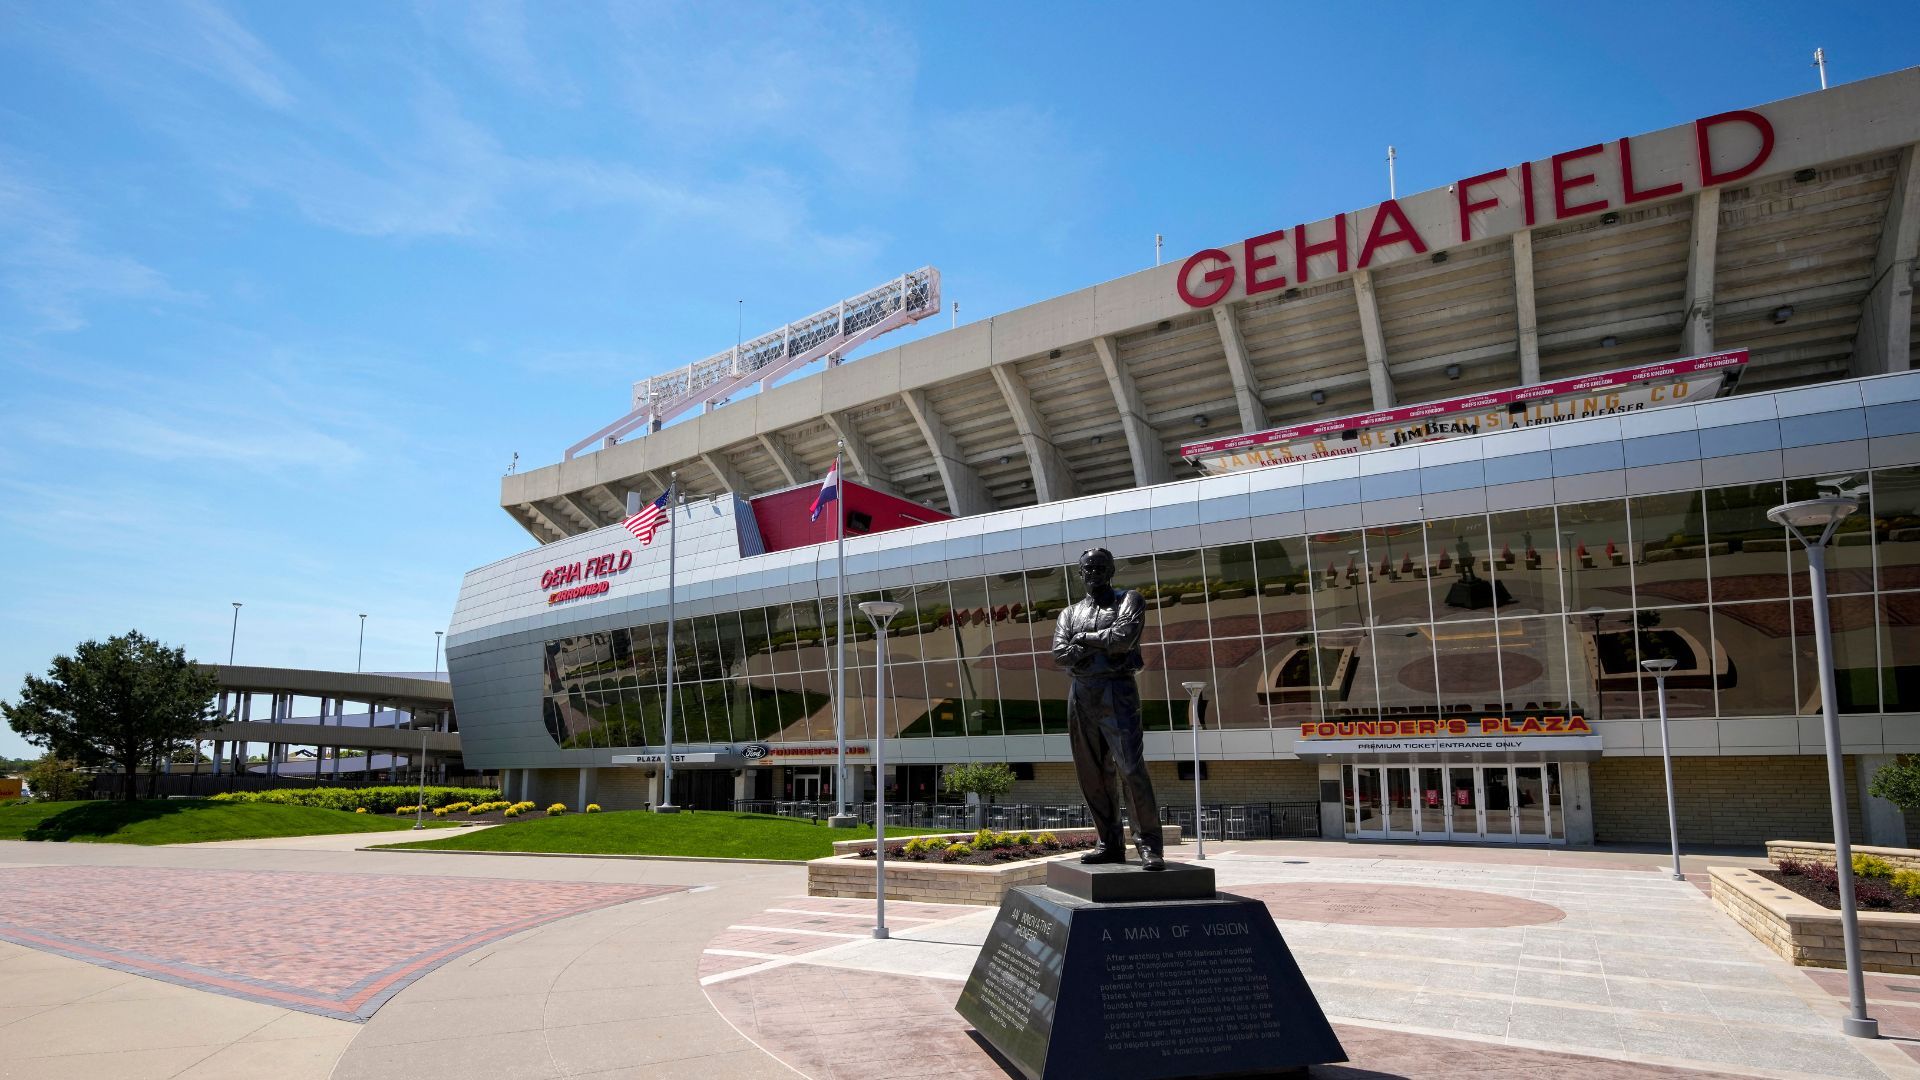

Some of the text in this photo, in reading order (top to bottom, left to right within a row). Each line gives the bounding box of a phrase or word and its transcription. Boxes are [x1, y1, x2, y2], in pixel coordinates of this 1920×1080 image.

[1176, 110, 1775, 307] GEHA FIELD
[1713, 358, 1738, 366] KINGDOM
[1651, 368, 1675, 377] KINGDOM
[1512, 421, 1519, 429] A
[1526, 413, 1575, 427] CROWN
[1390, 422, 1480, 447] JIM BEAM
[1219, 446, 1293, 469] JAMES
[1260, 446, 1358, 467] KENTUCKY STRAIGHT
[541, 549, 633, 590] GEHA FIELD
[556, 580, 609, 602] ARROWHEAD
[1300, 715, 1593, 738] FOUNDER'S PLAZA
[745, 746, 762, 758] Ford
[1102, 922, 1249, 941] A MAN OF VISION
[1106, 953, 1125, 961] After
[1128, 952, 1160, 961] watching
[1194, 949, 1223, 957] National
[1224, 947, 1252, 955] Football
[1106, 963, 1134, 971] League
[1136, 960, 1184, 969] Championship
[1113, 973, 1135, 981] Lamar
[1138, 971, 1154, 979] Hunt
[1156, 969, 1196, 977] recognized
[1211, 966, 1253, 974] tremendous
[1100, 983, 1132, 992] potential
[1135, 981, 1145, 989] for
[1149, 980, 1192, 989] professional
[1194, 977, 1221, 985] football
[1103, 1001, 1133, 1010] founded
